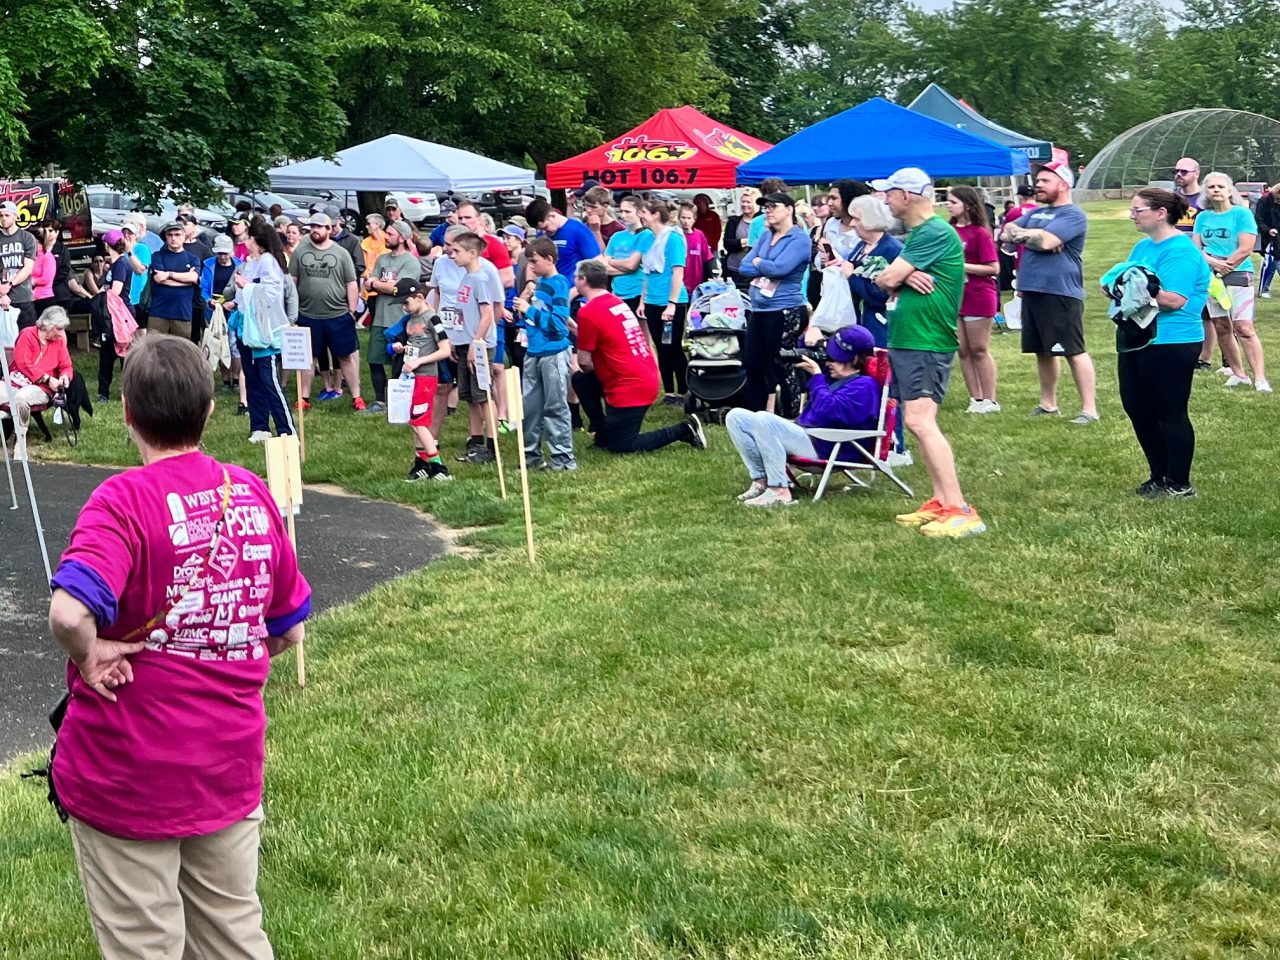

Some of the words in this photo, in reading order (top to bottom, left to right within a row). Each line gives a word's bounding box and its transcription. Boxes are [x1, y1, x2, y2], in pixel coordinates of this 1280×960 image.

[607, 147, 697, 163] 106.7
[583, 169, 631, 185] HOT
[640, 168, 699, 185] 106.7
[2, 254, 24, 269] WIN.
[183, 489, 218, 509] WEST
[216, 483, 252, 500] SORE
[224, 505, 270, 538] PSECU
[210, 589, 243, 605] GIANT
